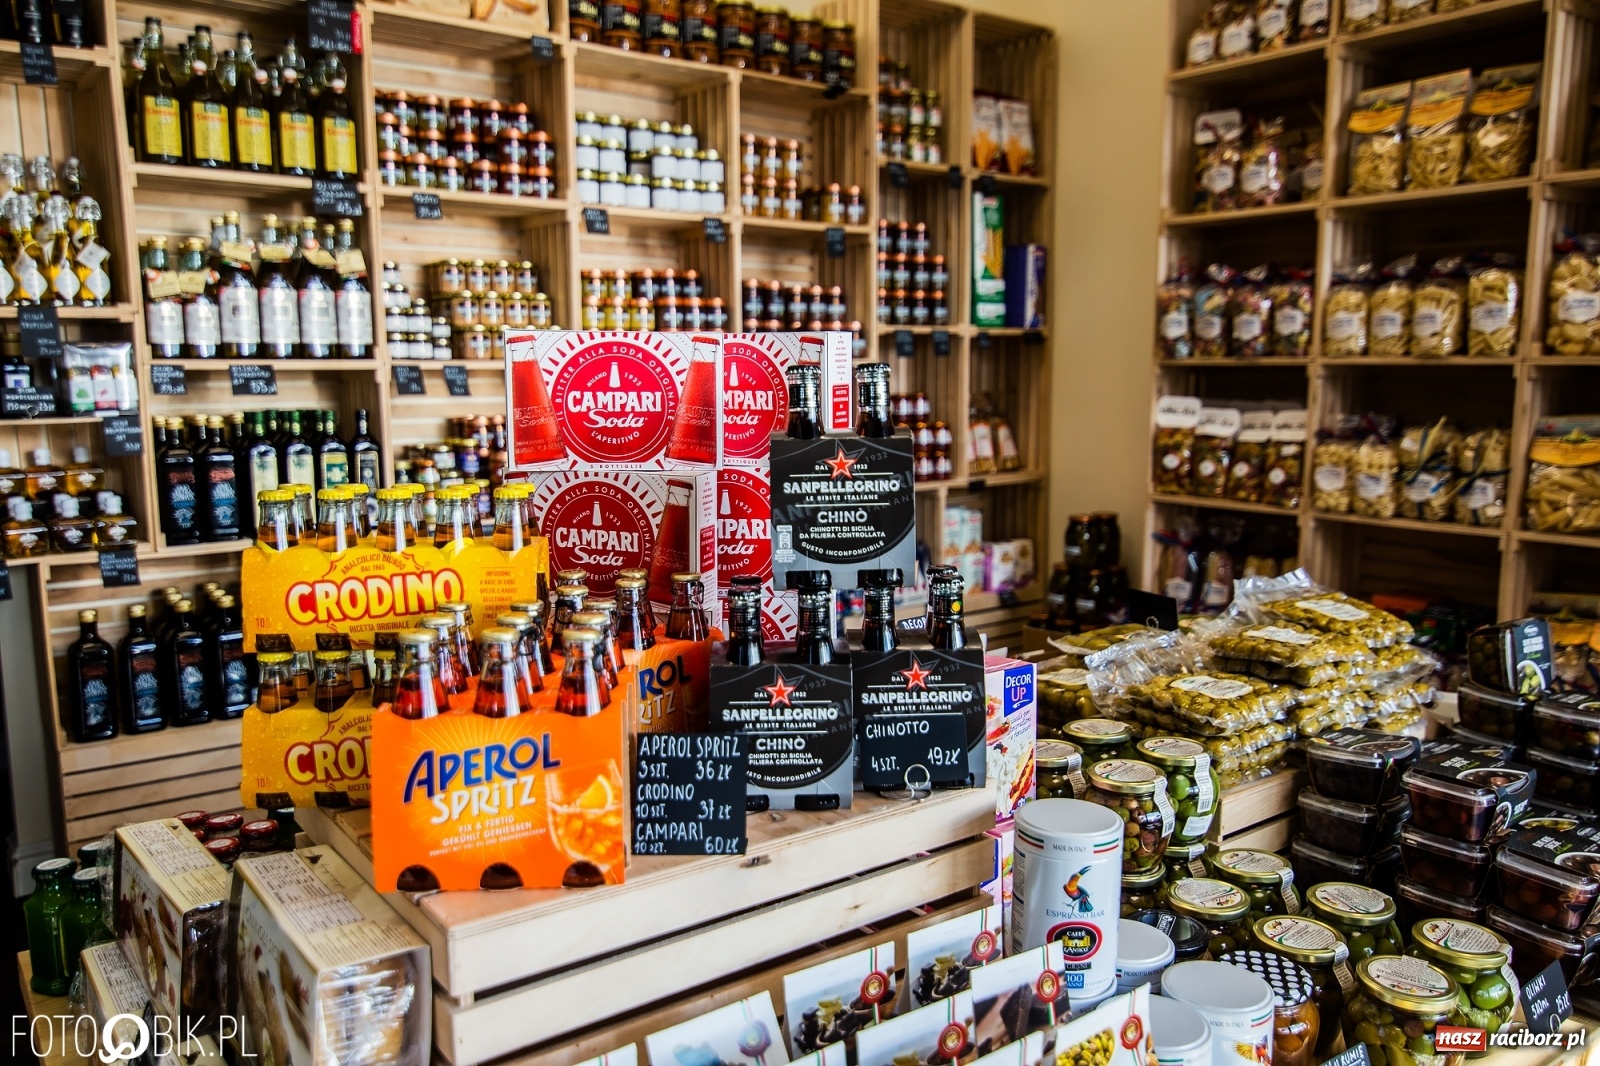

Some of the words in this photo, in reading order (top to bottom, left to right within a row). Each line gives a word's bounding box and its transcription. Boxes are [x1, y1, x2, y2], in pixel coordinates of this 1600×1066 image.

[554, 366, 575, 403] BITTER
[578, 347, 606, 365] ALLA
[612, 345, 644, 361] SODA
[649, 359, 675, 421] ORIGINALE
[586, 371, 608, 388] MILANO
[624, 371, 643, 387] 1932
[732, 346, 757, 360] SODA
[761, 360, 785, 420] ORIGINALE
[741, 371, 756, 386] 1932
[567, 390, 662, 413] CAMPARI
[723, 390, 774, 410] MPARI
[583, 408, 645, 428] Soda
[591, 430, 640, 445] L'APERITIVO
[723, 472, 754, 487] SODA
[783, 480, 899, 494] SANPELLEGRINO
[735, 499, 752, 514] 1932
[565, 486, 588, 502] ALLA
[594, 485, 622, 500] SODA
[627, 501, 651, 562] ORIGINALE
[572, 510, 591, 525] MILANO
[605, 511, 622, 527] 1932
[817, 508, 868, 523] CHINÒ
[555, 526, 640, 553] CAMPARI
[717, 540, 756, 555] oda
[569, 545, 625, 566] Soda
[801, 541, 824, 554] GUSTO
[825, 540, 885, 557] INCONFONDIBILE
[341, 554, 380, 575] ANALCOLICO
[382, 554, 406, 571] BIONDO
[285, 568, 465, 626] CRODINO
[349, 623, 375, 633] RICETTA
[377, 621, 410, 630] ORIGINALE
[1005, 674, 1032, 688] DECOR
[861, 691, 972, 704] SANPELLEGRINO
[1011, 687, 1027, 702] UP
[722, 707, 838, 721] SANPELLEGRINO
[865, 720, 930, 739] CHINOTTO
[640, 735, 691, 758] APEROL
[696, 736, 741, 758] SPRITZ
[756, 735, 806, 751] CHINÒ
[403, 732, 561, 804] APEROL
[638, 760, 648, 778] 3
[695, 760, 715, 780] 36
[763, 767, 822, 782] INCONFONDIBILE
[638, 783, 695, 801] CRODINO
[636, 803, 649, 818] 10
[698, 799, 714, 820] 37
[459, 825, 472, 834] FIX
[476, 822, 482, 830] &
[486, 815, 514, 828] FERTIG
[636, 821, 703, 840] CAMPARI
[442, 832, 481, 847] GEKÜHLT
[484, 821, 533, 839] GENIESSEN
[429, 848, 451, 857] PERFEKT
[635, 841, 647, 853] 10
[1046, 909, 1088, 920] ESPRESSO
[1091, 910, 1105, 919] BAR
[1067, 974, 1083, 982] 100
[1525, 974, 1547, 1000] OLIWKI
